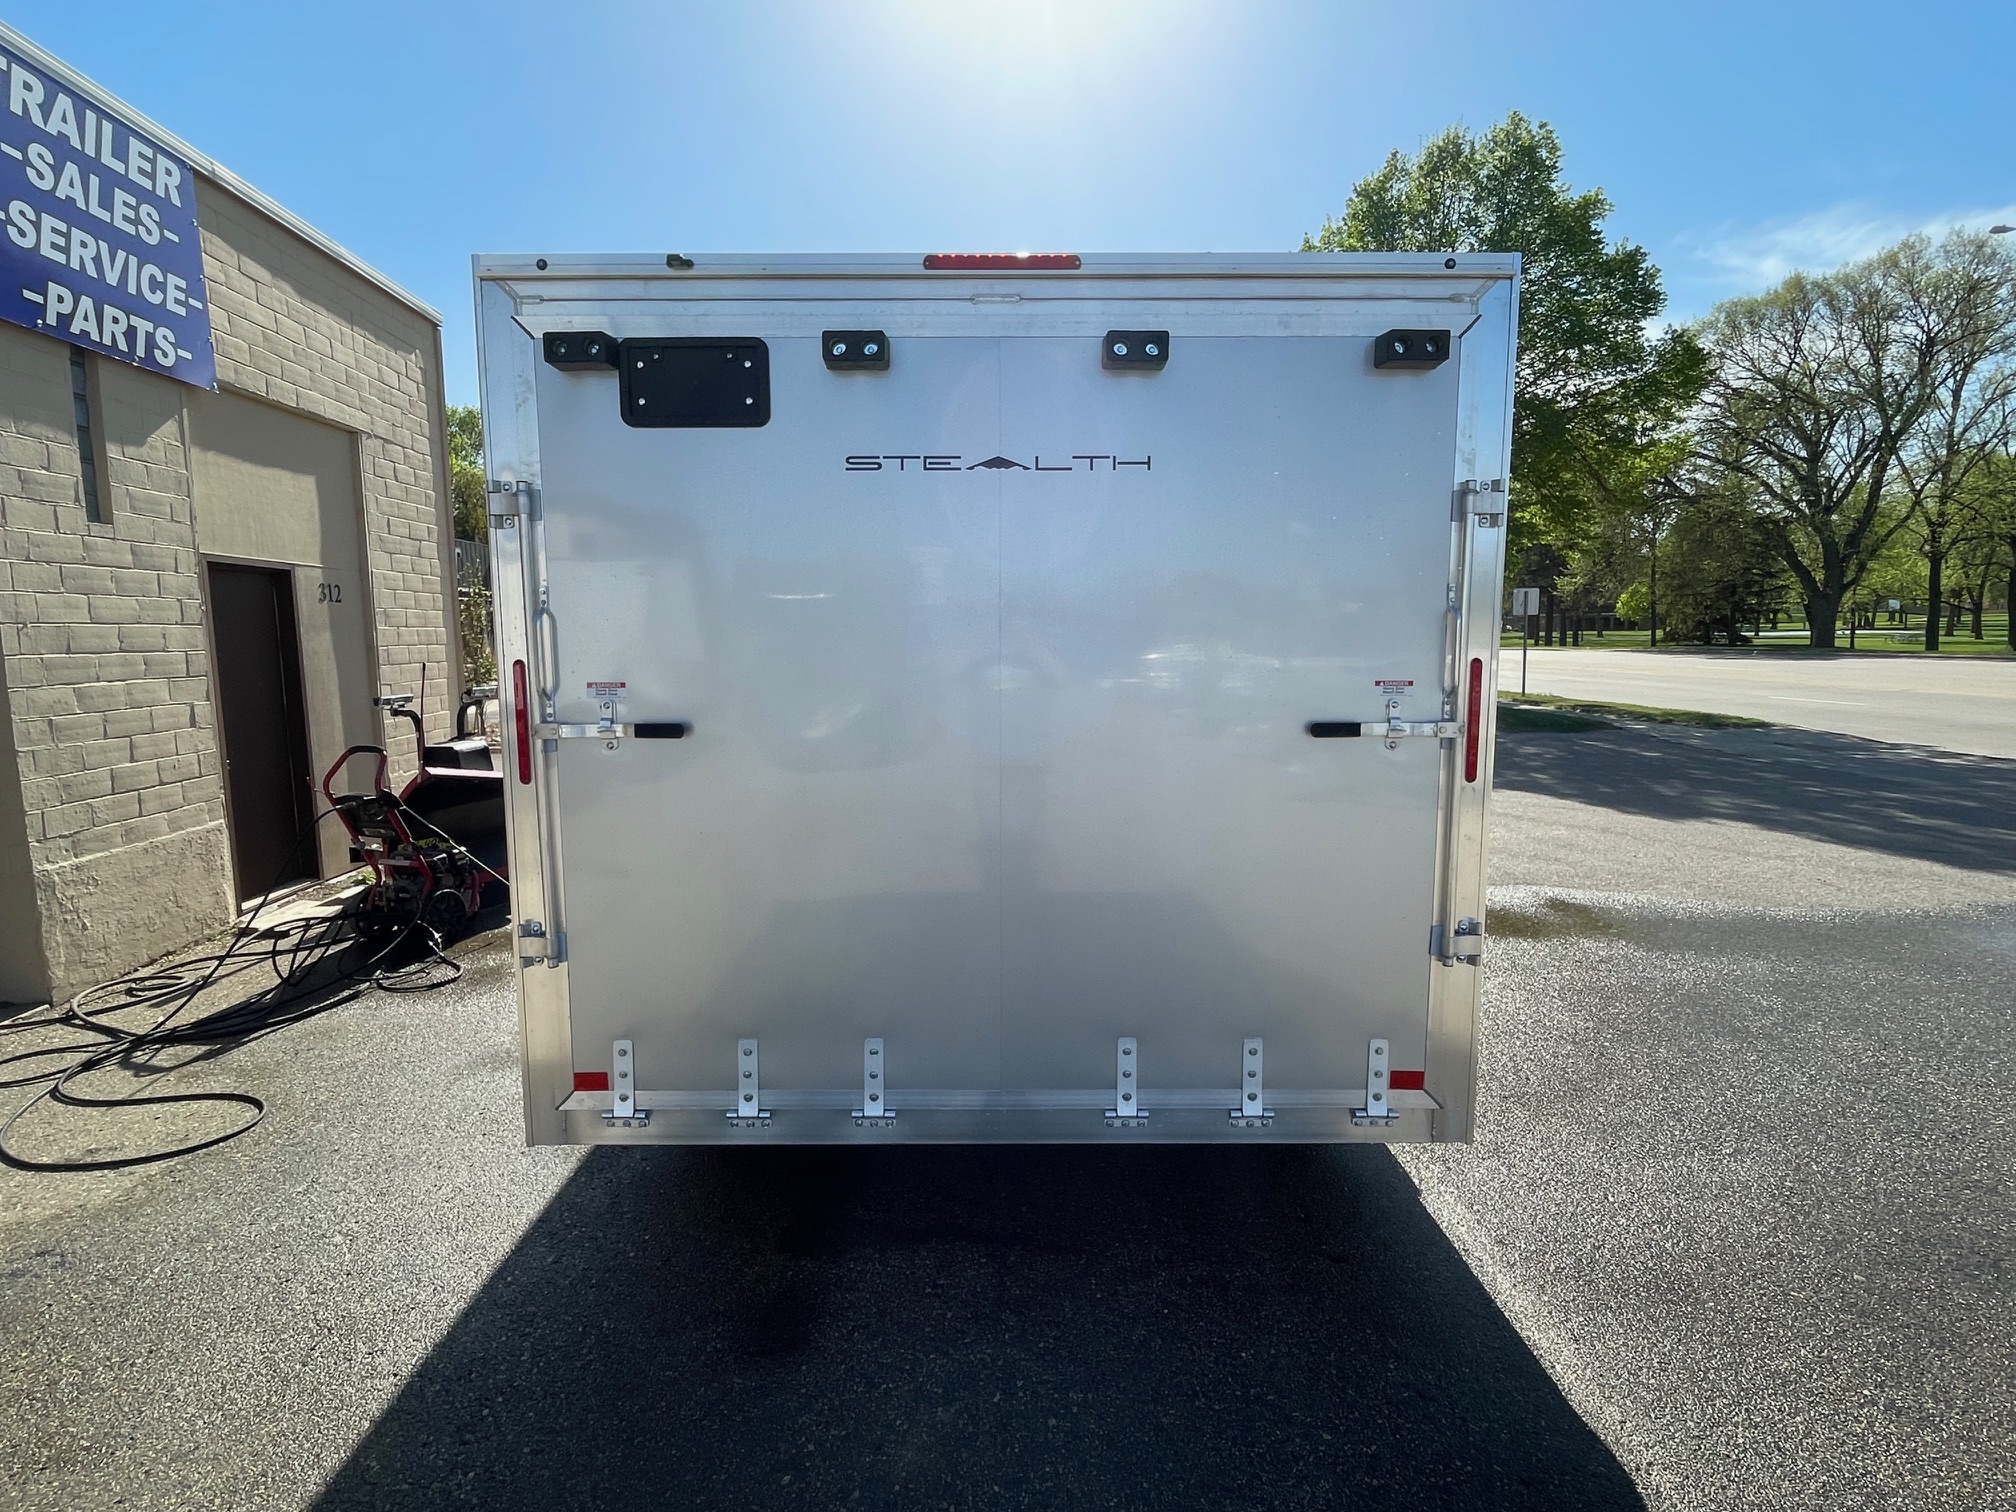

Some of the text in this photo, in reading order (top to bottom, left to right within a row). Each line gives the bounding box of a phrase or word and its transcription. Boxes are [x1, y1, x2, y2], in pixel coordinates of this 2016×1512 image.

[1, 142, 179, 246] -SALES-
[0, 200, 203, 317] SERVICE-
[22, 281, 192, 367] -PARTS-
[845, 455, 1151, 471] STEALTH
[317, 582, 342, 604] 312
